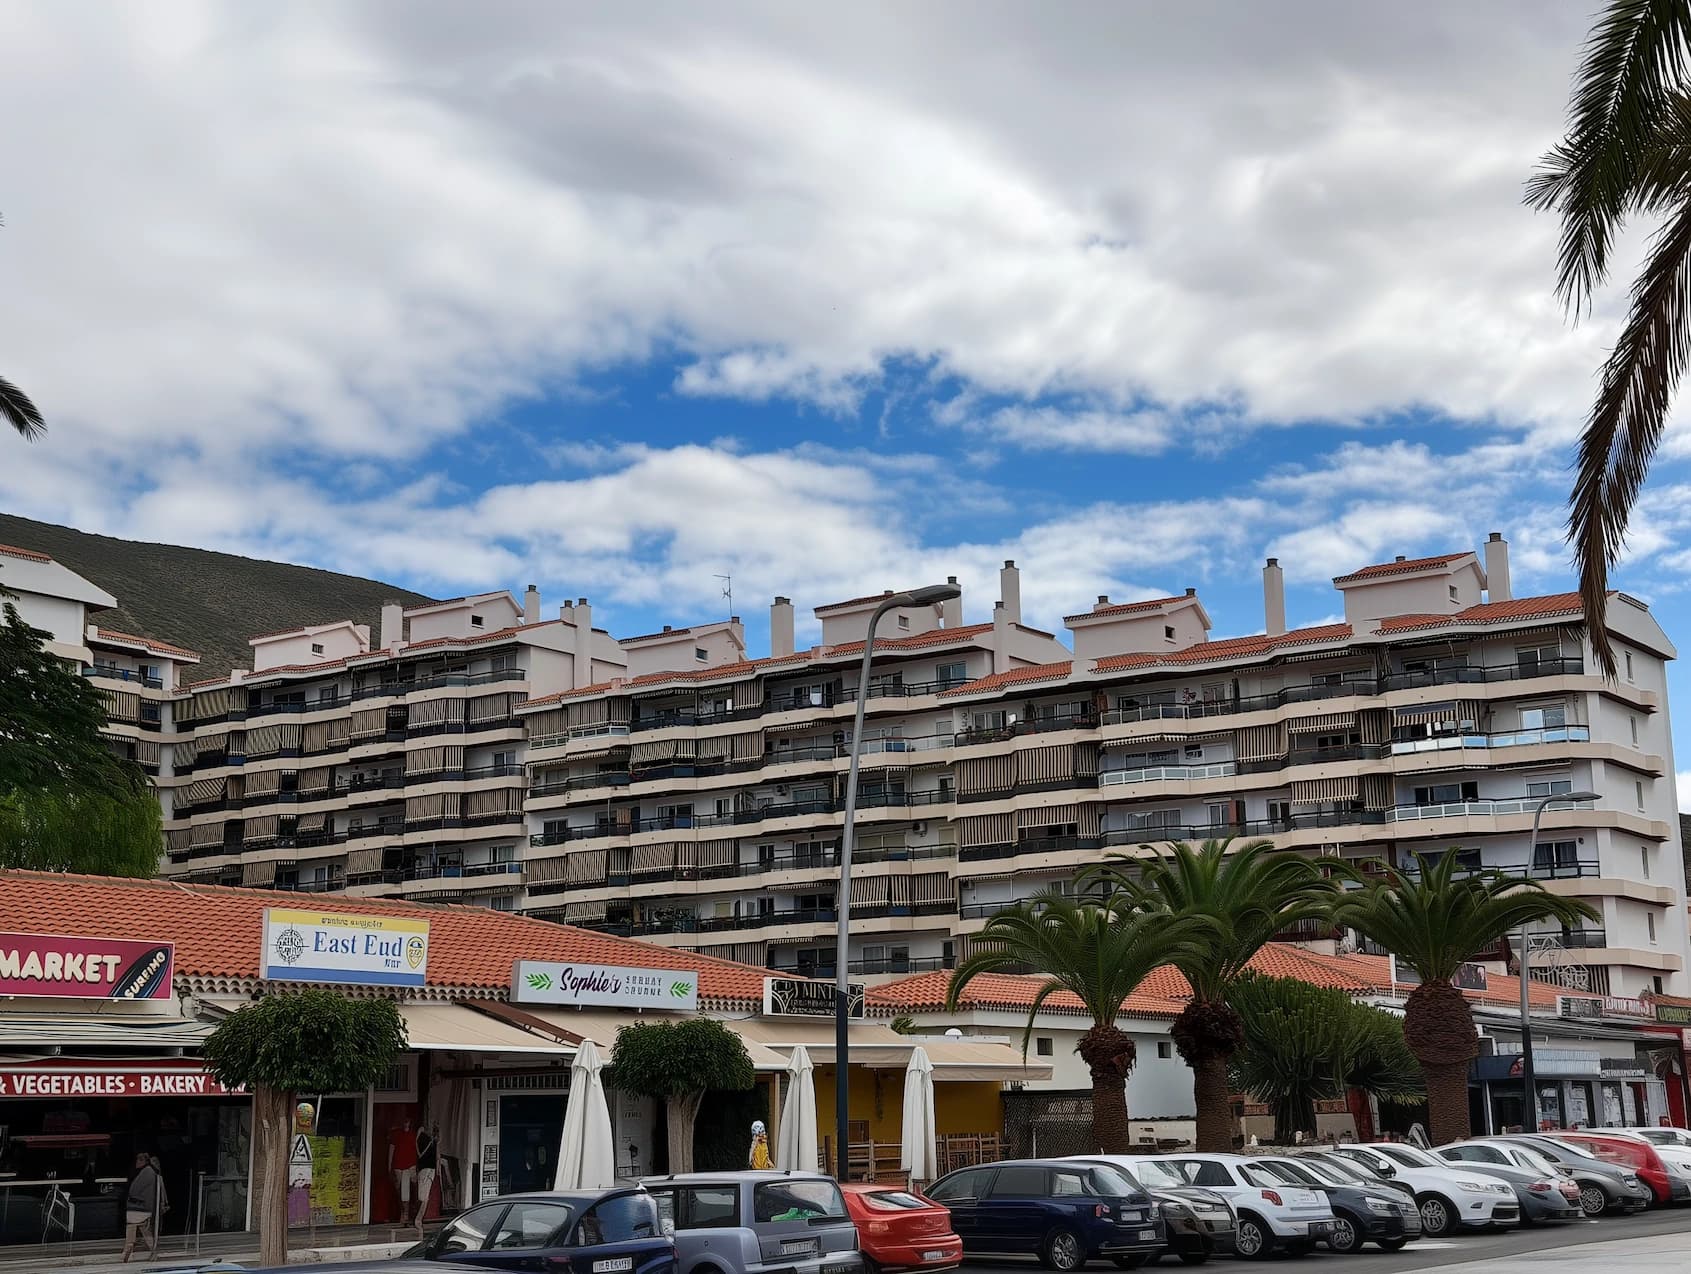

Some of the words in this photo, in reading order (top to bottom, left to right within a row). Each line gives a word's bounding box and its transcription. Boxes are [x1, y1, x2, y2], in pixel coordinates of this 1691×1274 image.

[314, 931, 356, 954] East
[0, 949, 121, 982] MARKET
[12, 1075, 125, 1094] VEGETABLES
[140, 1075, 206, 1093] BAKERY
